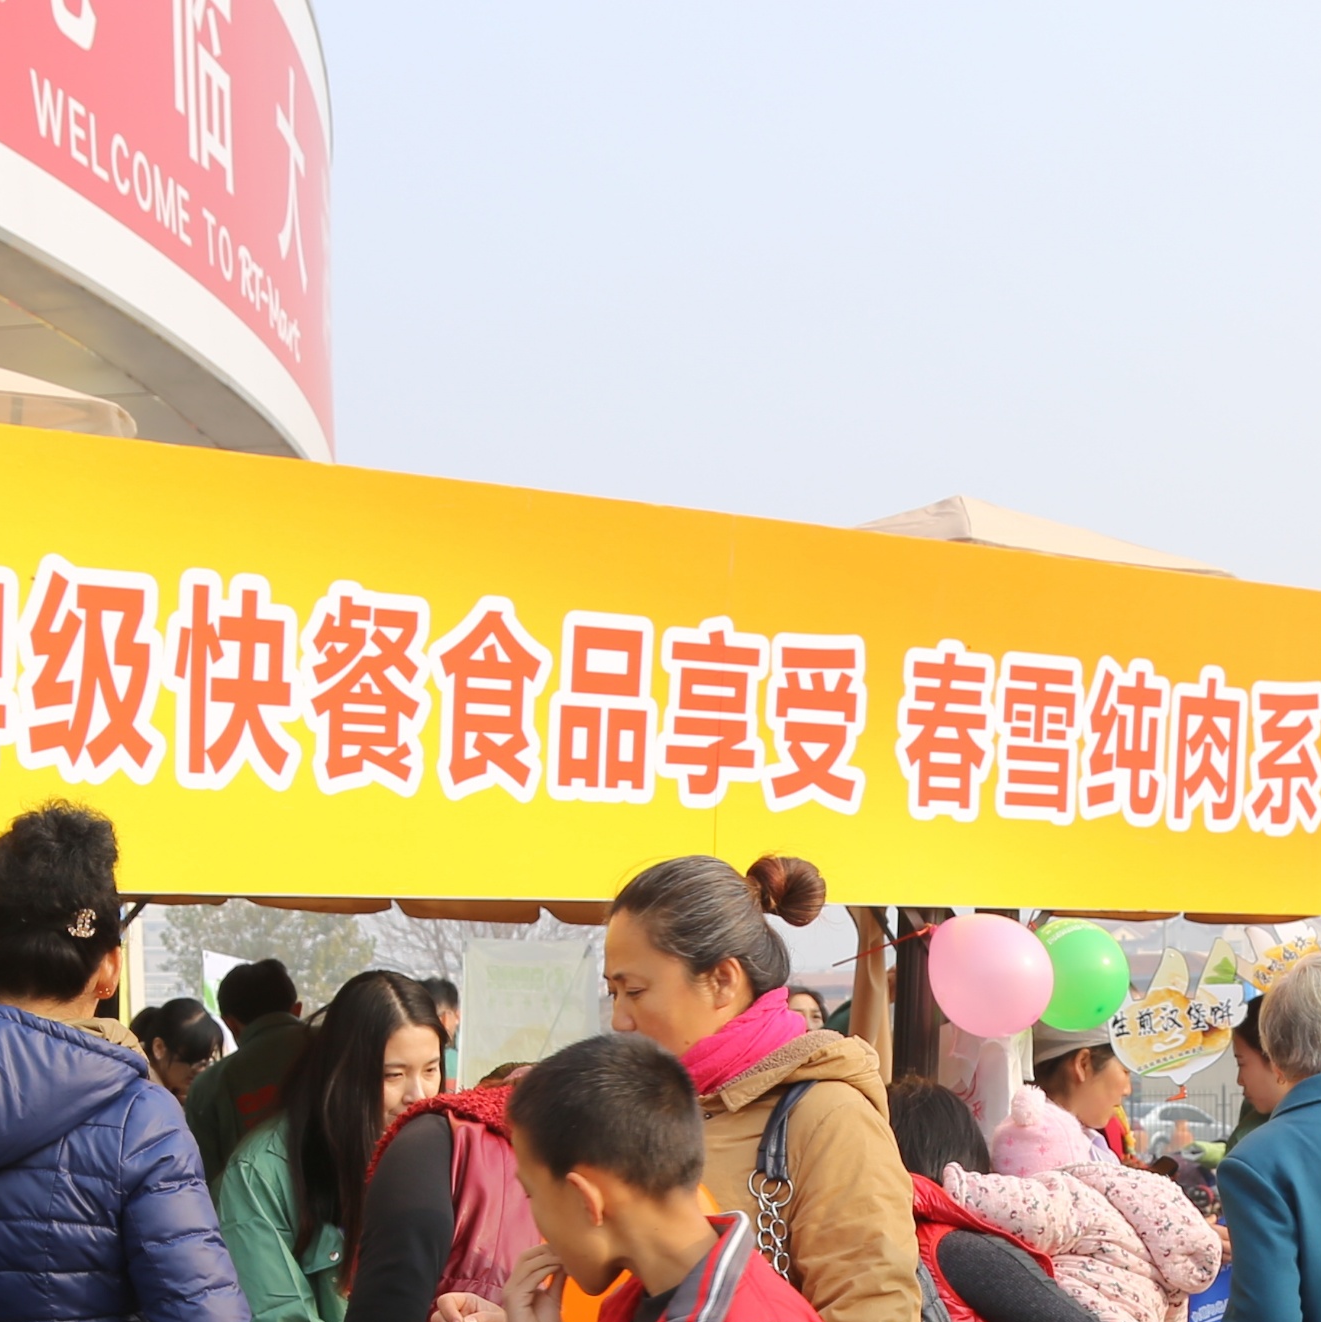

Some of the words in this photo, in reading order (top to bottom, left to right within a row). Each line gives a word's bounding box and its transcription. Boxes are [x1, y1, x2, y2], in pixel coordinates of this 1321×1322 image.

[30, 67, 193, 248] WELCOME
[202, 206, 234, 283] TO
[238, 245, 302, 364] RT-Mart
